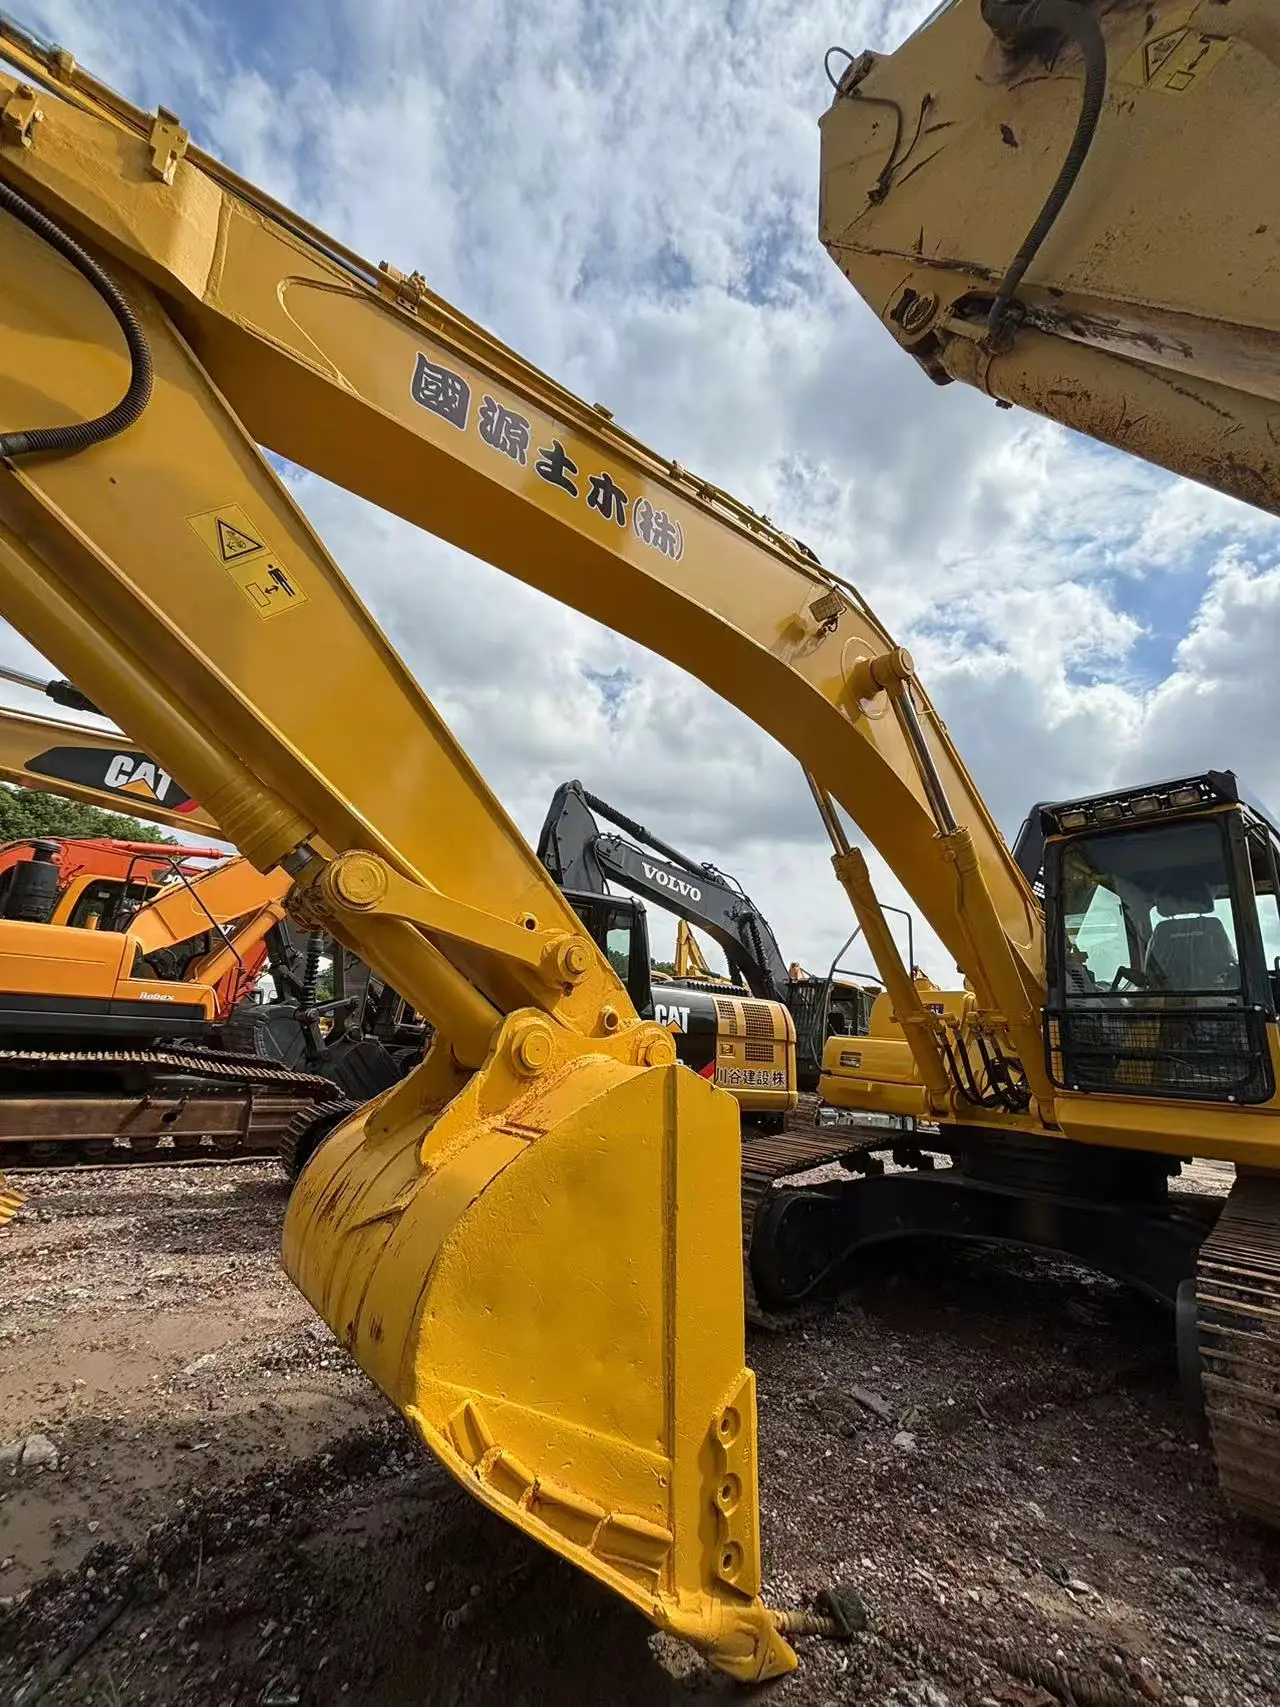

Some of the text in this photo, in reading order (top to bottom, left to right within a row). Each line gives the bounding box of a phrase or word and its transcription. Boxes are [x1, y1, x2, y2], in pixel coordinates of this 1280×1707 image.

[104, 755, 172, 801] CAT
[641, 861, 702, 902] VOLVO
[654, 1004, 691, 1034] CAT
